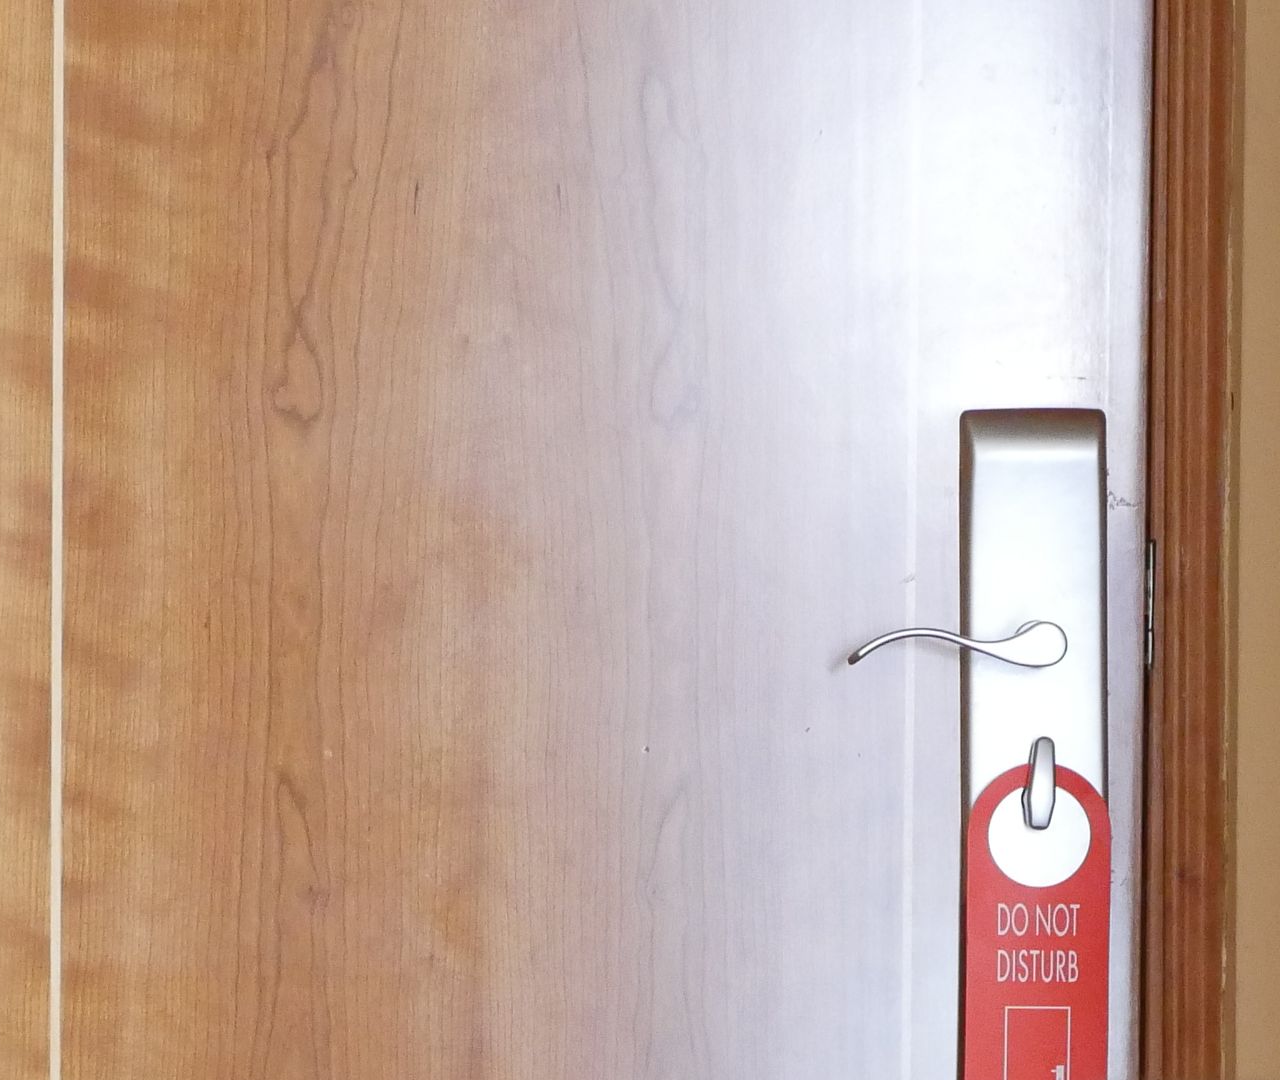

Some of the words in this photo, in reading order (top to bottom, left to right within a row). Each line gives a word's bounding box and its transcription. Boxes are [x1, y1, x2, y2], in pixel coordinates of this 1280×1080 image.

[997, 903, 1029, 937] DO
[1035, 903, 1081, 937] NOT
[997, 949, 1079, 983] DISTURB
